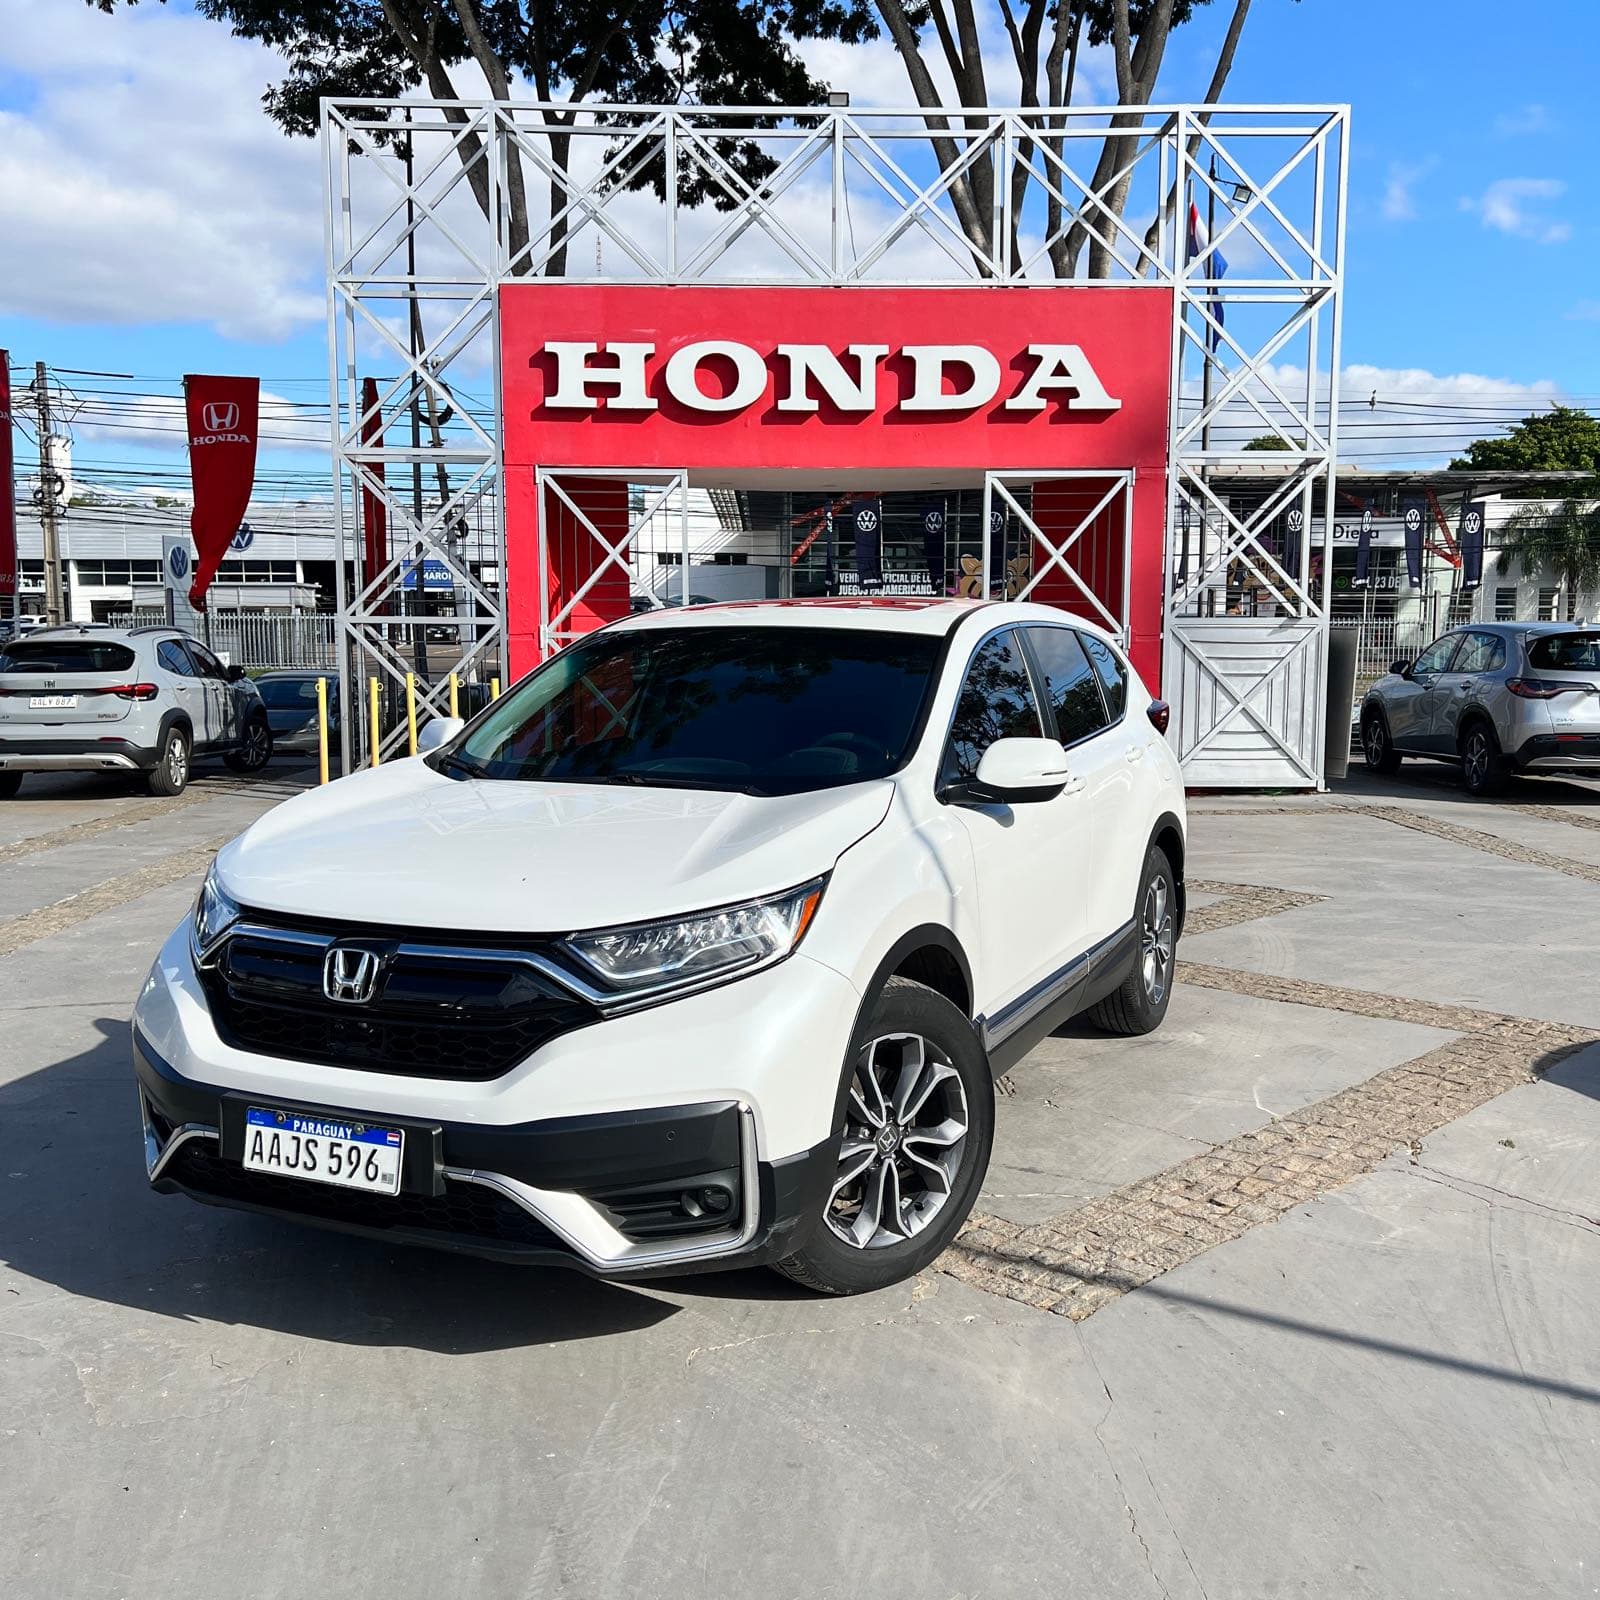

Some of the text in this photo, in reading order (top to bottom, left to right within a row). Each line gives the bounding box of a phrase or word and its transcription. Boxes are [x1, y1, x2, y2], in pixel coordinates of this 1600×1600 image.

[544, 341, 1122, 411] HONDA
[192, 433, 251, 446] HONDA
[1333, 524, 1379, 539] Diea
[911, 572, 922, 583] DE
[1375, 576, 1386, 588] 23
[293, 1119, 352, 1139] PARAGUAY
[250, 1129, 379, 1182] AAJS 596
